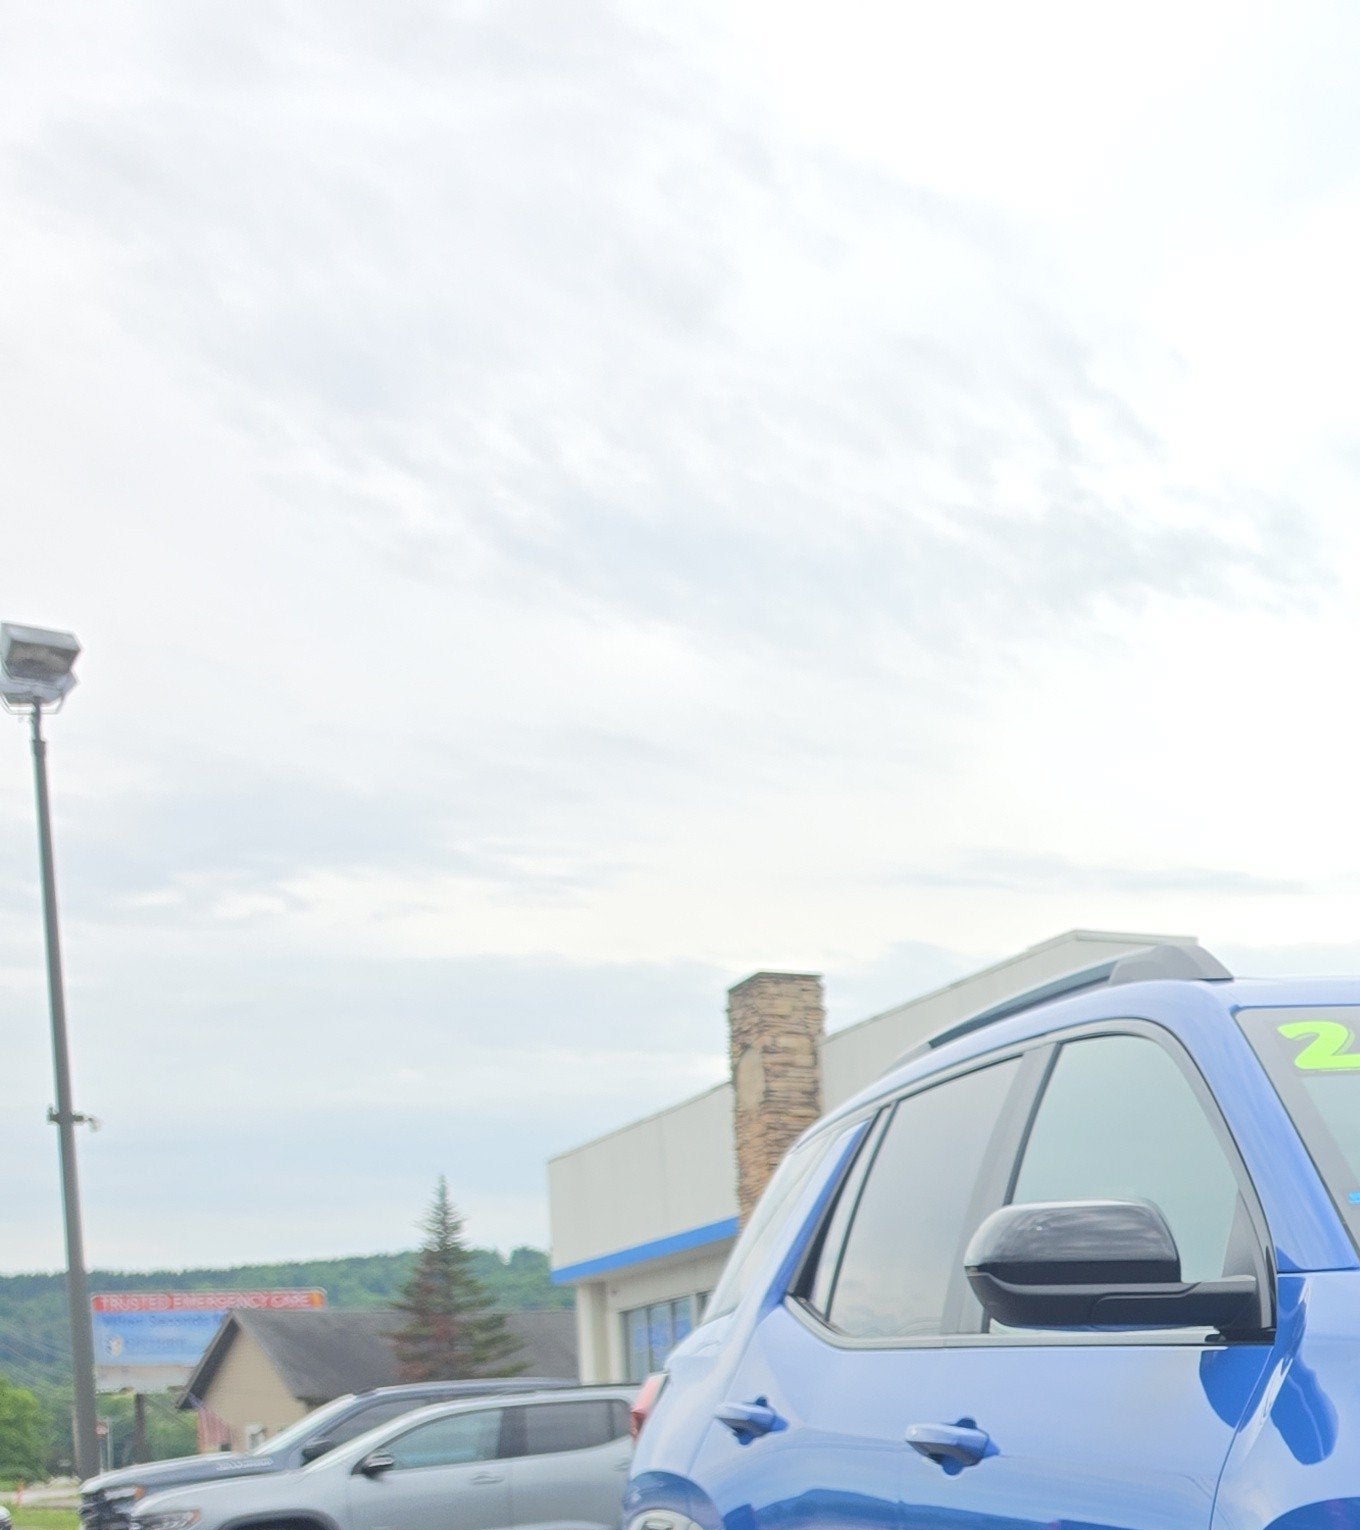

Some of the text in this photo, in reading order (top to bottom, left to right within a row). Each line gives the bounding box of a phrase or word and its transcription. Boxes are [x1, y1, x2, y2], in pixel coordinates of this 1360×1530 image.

[103, 1290, 311, 1310] TRUSTED EMERGENCY CARE
